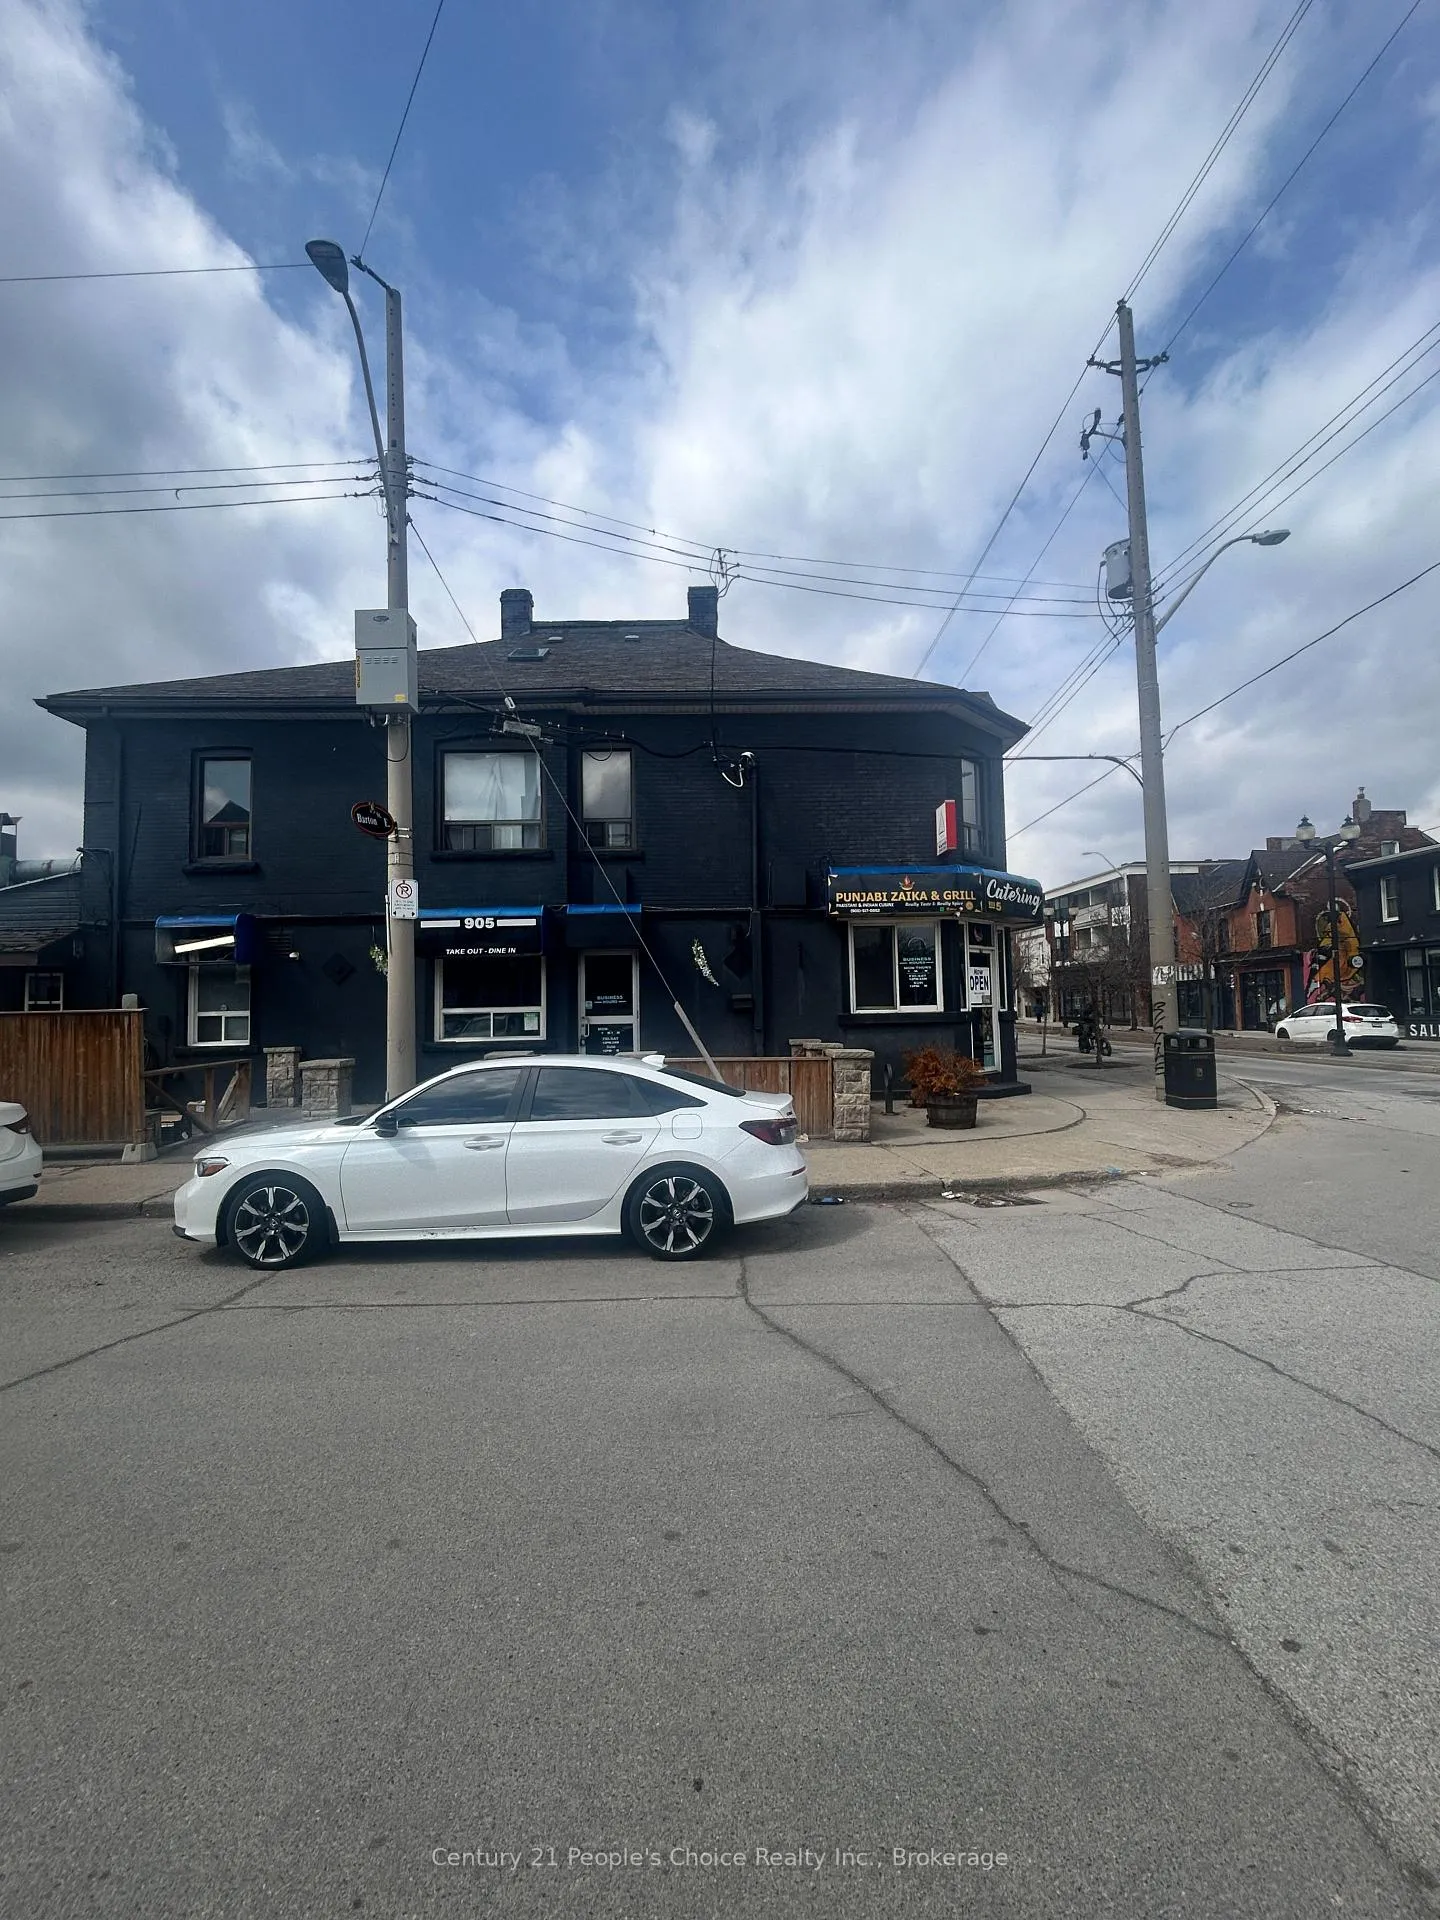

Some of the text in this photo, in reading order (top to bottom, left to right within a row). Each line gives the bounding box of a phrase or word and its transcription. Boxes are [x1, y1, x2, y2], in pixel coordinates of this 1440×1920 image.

[356, 813, 378, 826] Barton
[836, 890, 976, 902] PUNJABI ZAIKA & GRILL
[986, 879, 1042, 915] Catering
[464, 917, 495, 929] 905
[969, 975, 989, 991] OPEN
[1409, 1024, 1440, 1037] SAL
